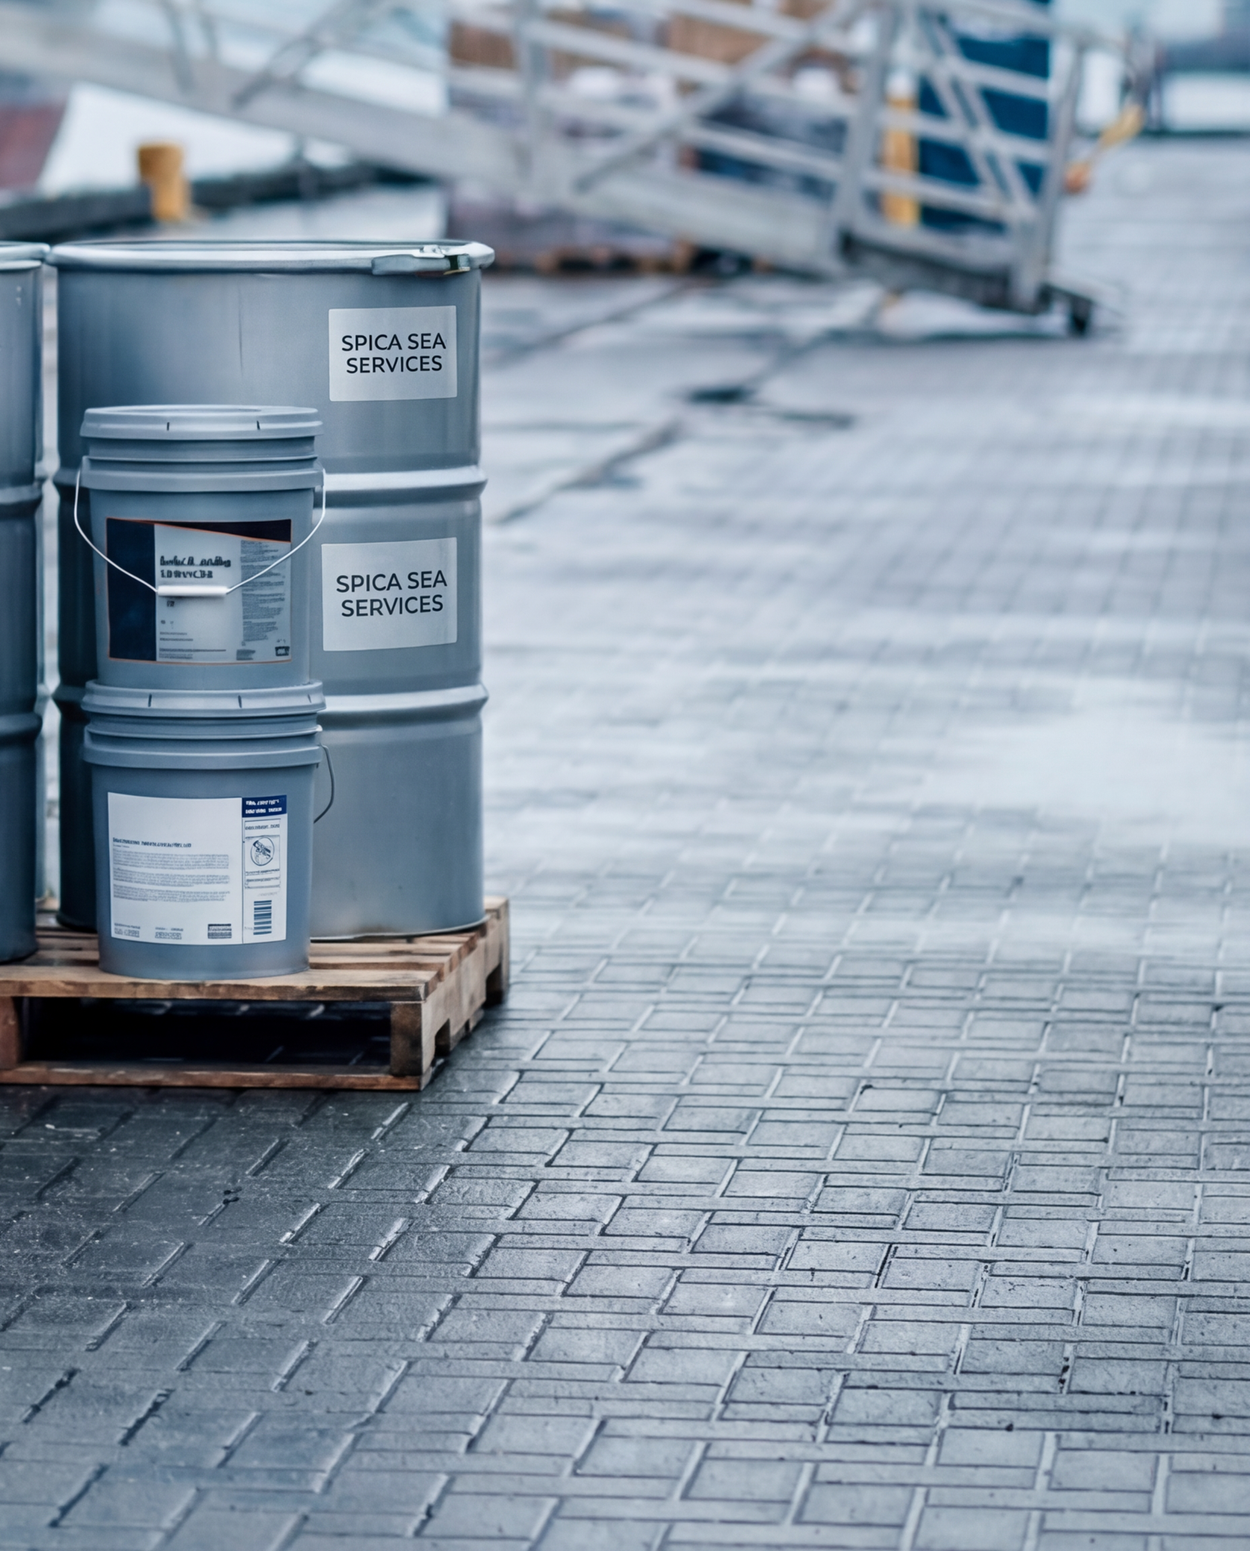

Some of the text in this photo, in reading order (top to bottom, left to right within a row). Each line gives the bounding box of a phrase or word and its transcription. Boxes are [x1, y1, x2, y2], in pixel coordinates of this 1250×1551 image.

[341, 332, 447, 352] SPICA SEA
[346, 355, 443, 374] SERVICES
[336, 570, 448, 593] SPICA SEA
[341, 594, 444, 618] SERVICES
